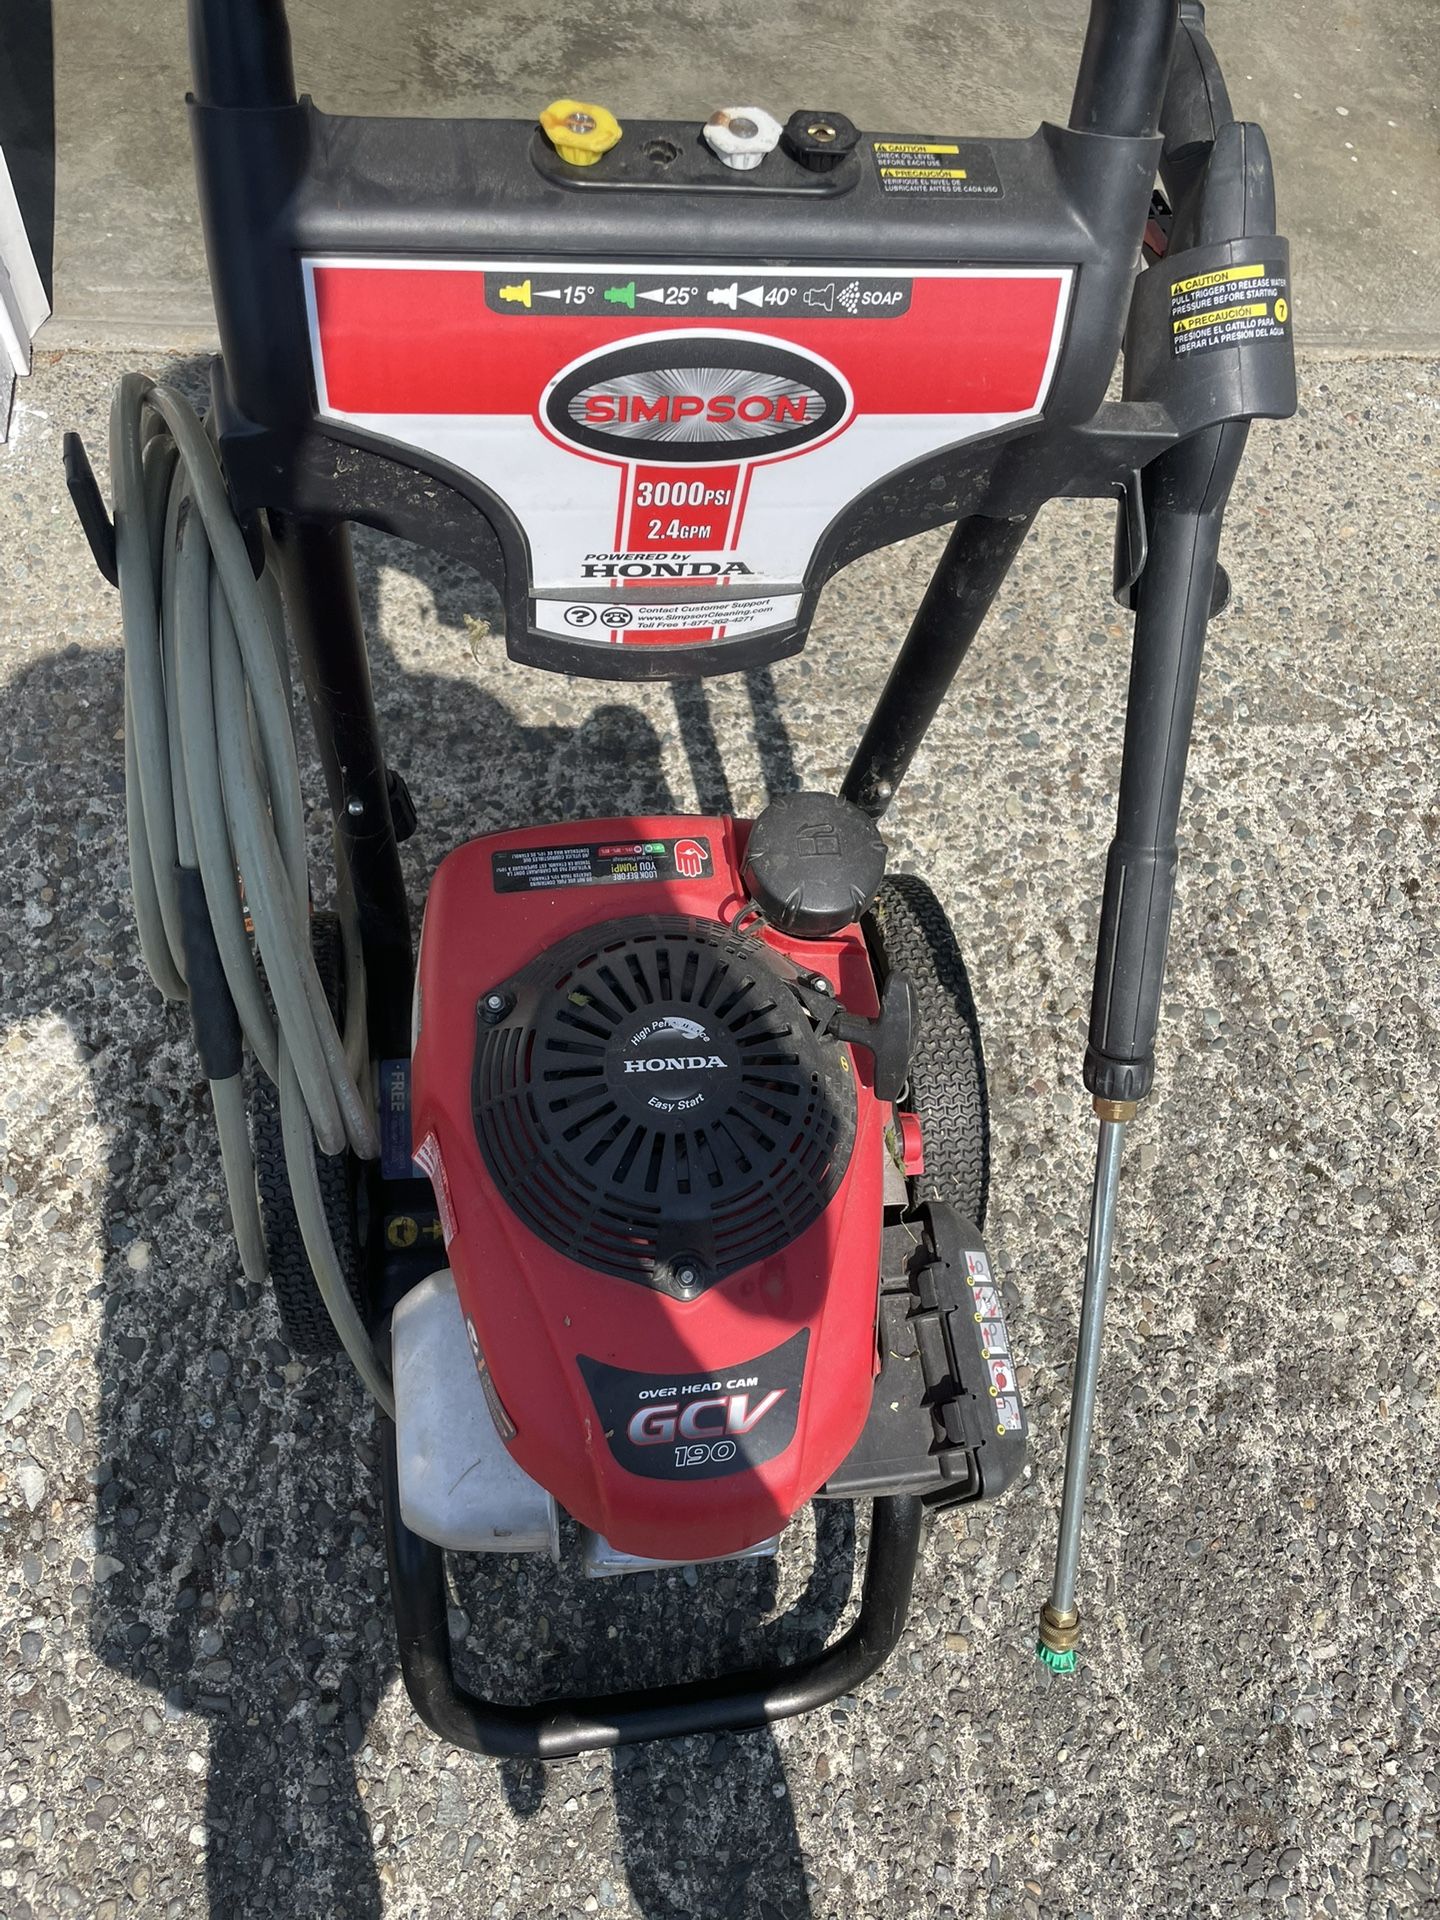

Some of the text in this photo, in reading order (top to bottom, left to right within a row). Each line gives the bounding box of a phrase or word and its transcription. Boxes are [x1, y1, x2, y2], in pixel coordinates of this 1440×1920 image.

[1185, 272, 1229, 290] CAUTION
[563, 285, 903, 306] 15° 25° 40° SOAP
[1172, 279, 1287, 307] PULL TRIGGER TO RELEASE WATER
[1172, 288, 1278, 316] PRESSURE BEFORE STARTING
[1188, 306, 1252, 328] PRECAUCIÓN
[1278, 304, 1285, 319] 7
[1174, 318, 1275, 344] PRESIONE EL GATILLO PARA
[1175, 339, 1207, 354] LIBERAR
[1208, 336, 1219, 346] LA
[1255, 328, 1268, 338] DEL
[1269, 327, 1285, 336] AGUA
[584, 395, 812, 423] SIMPSON
[584, 553, 691, 562] POWERED by
[580, 561, 755, 578] HONDA
[637, 606, 774, 622] www.SimpsonCleaning.com
[681, 603, 730, 612] Customer
[731, 599, 772, 609] Support
[682, 615, 755, 628] 1-877-362-4271
[611, 862, 656, 873] YOU PUMP!
[612, 870, 658, 880] LOOK BEFORE
[630, 1027, 651, 1046] High
[623, 1055, 728, 1073] HONDA
[648, 1093, 705, 1113] Easy Start
[638, 1377, 758, 1400] OVER HEAD CAM
[628, 1388, 788, 1446] GCV
[675, 1440, 737, 1468] 190
